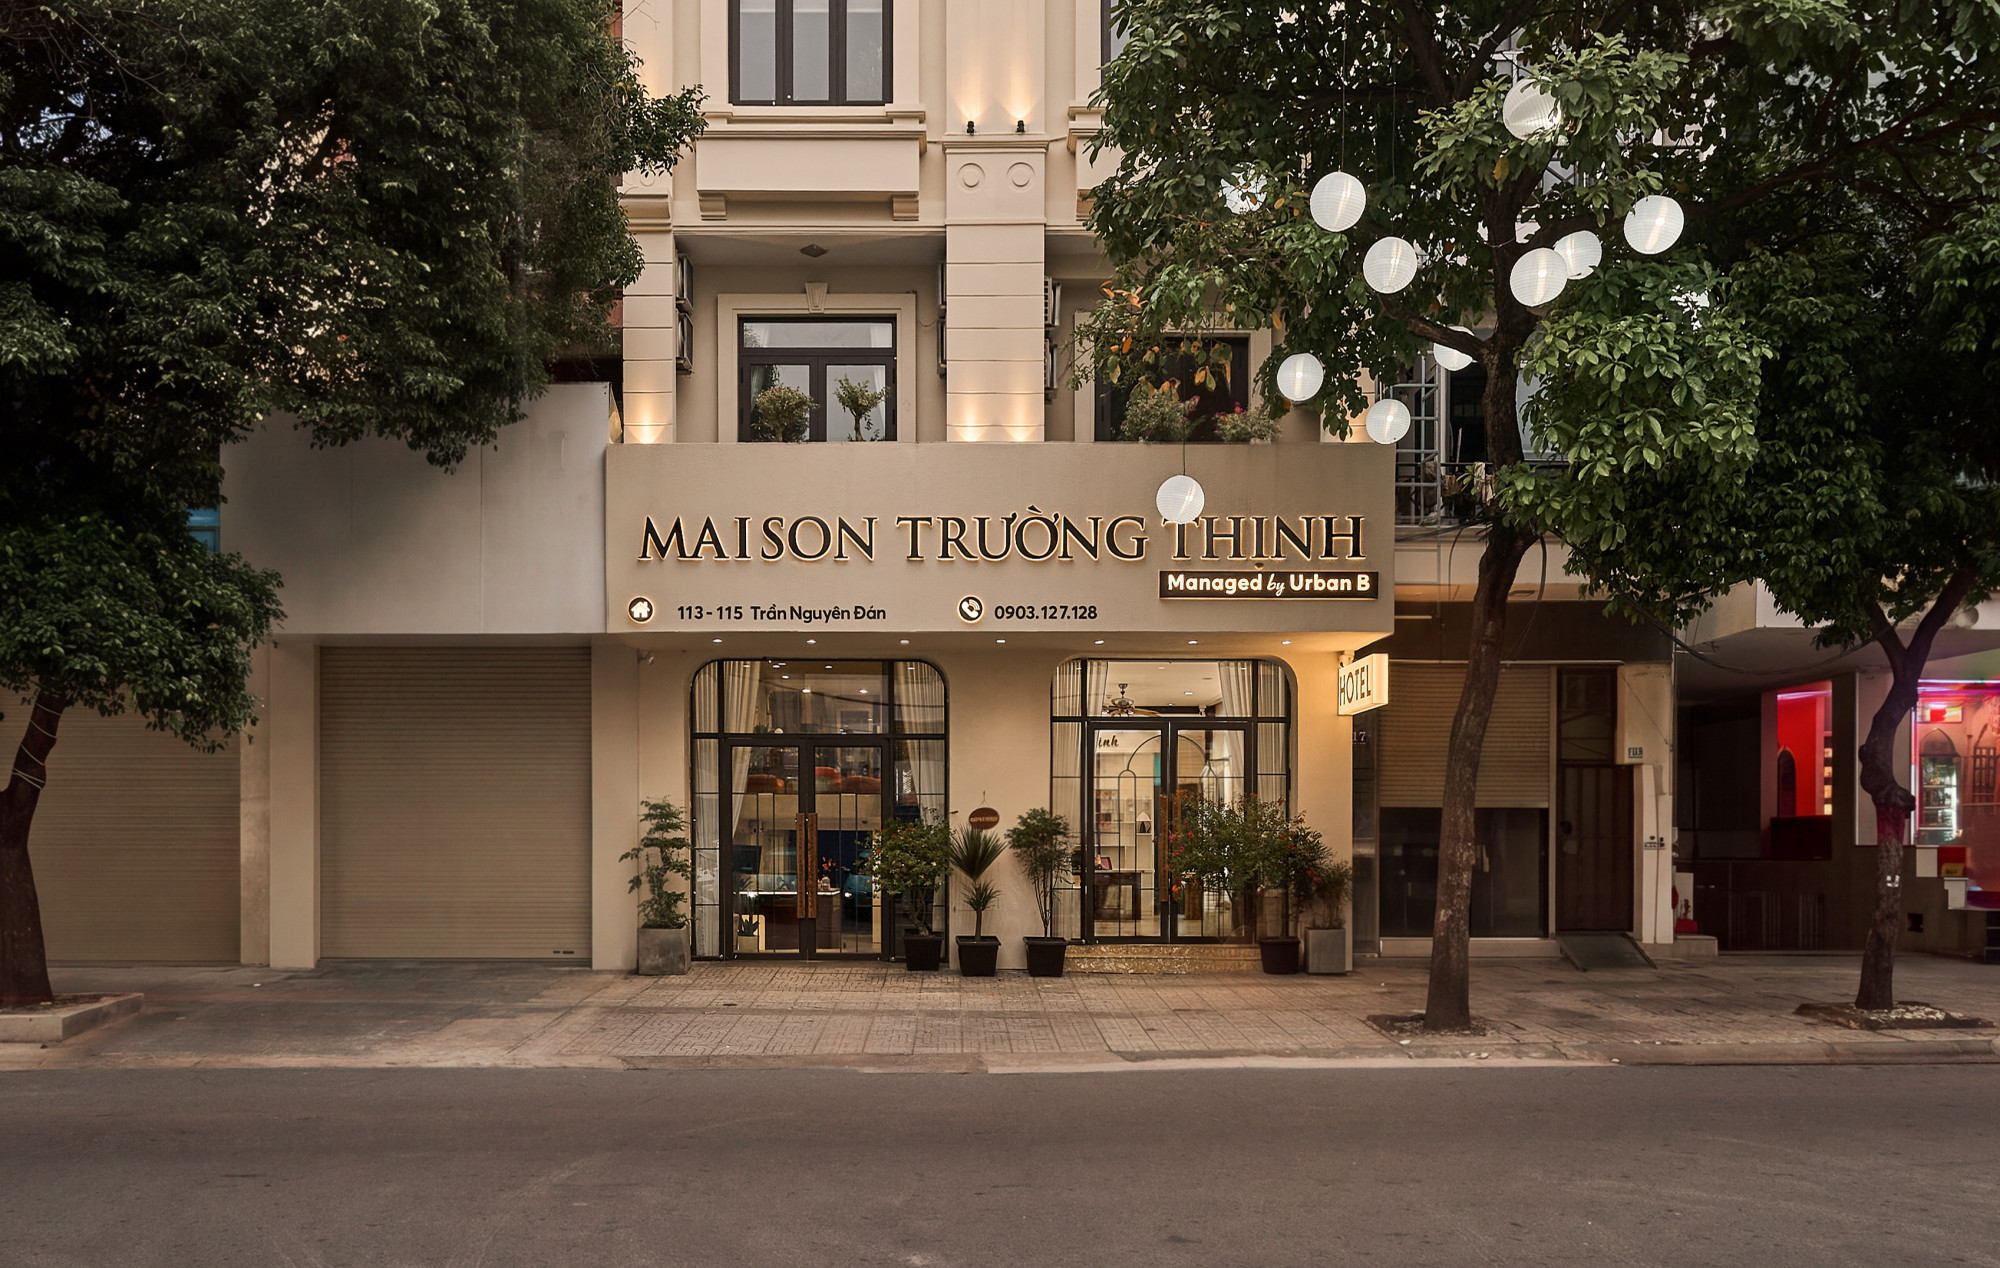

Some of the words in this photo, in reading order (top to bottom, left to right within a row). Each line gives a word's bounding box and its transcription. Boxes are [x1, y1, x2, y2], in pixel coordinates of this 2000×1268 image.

[638, 515, 878, 562] MAISON
[896, 504, 1149, 562] TRƯỜNG
[1163, 515, 1366, 570] THỊNH
[1167, 573, 1263, 595] Managed
[1266, 573, 1286, 597] by
[1289, 573, 1352, 592] Urban
[1356, 573, 1371, 592] B
[677, 605, 704, 620] 113
[716, 605, 743, 620] 115
[750, 603, 787, 620] Trần
[789, 605, 850, 623] Nguyên
[853, 605, 886, 620] Đán
[994, 605, 1098, 620] 0903.127.128
[1339, 664, 1371, 706] HOTEL
